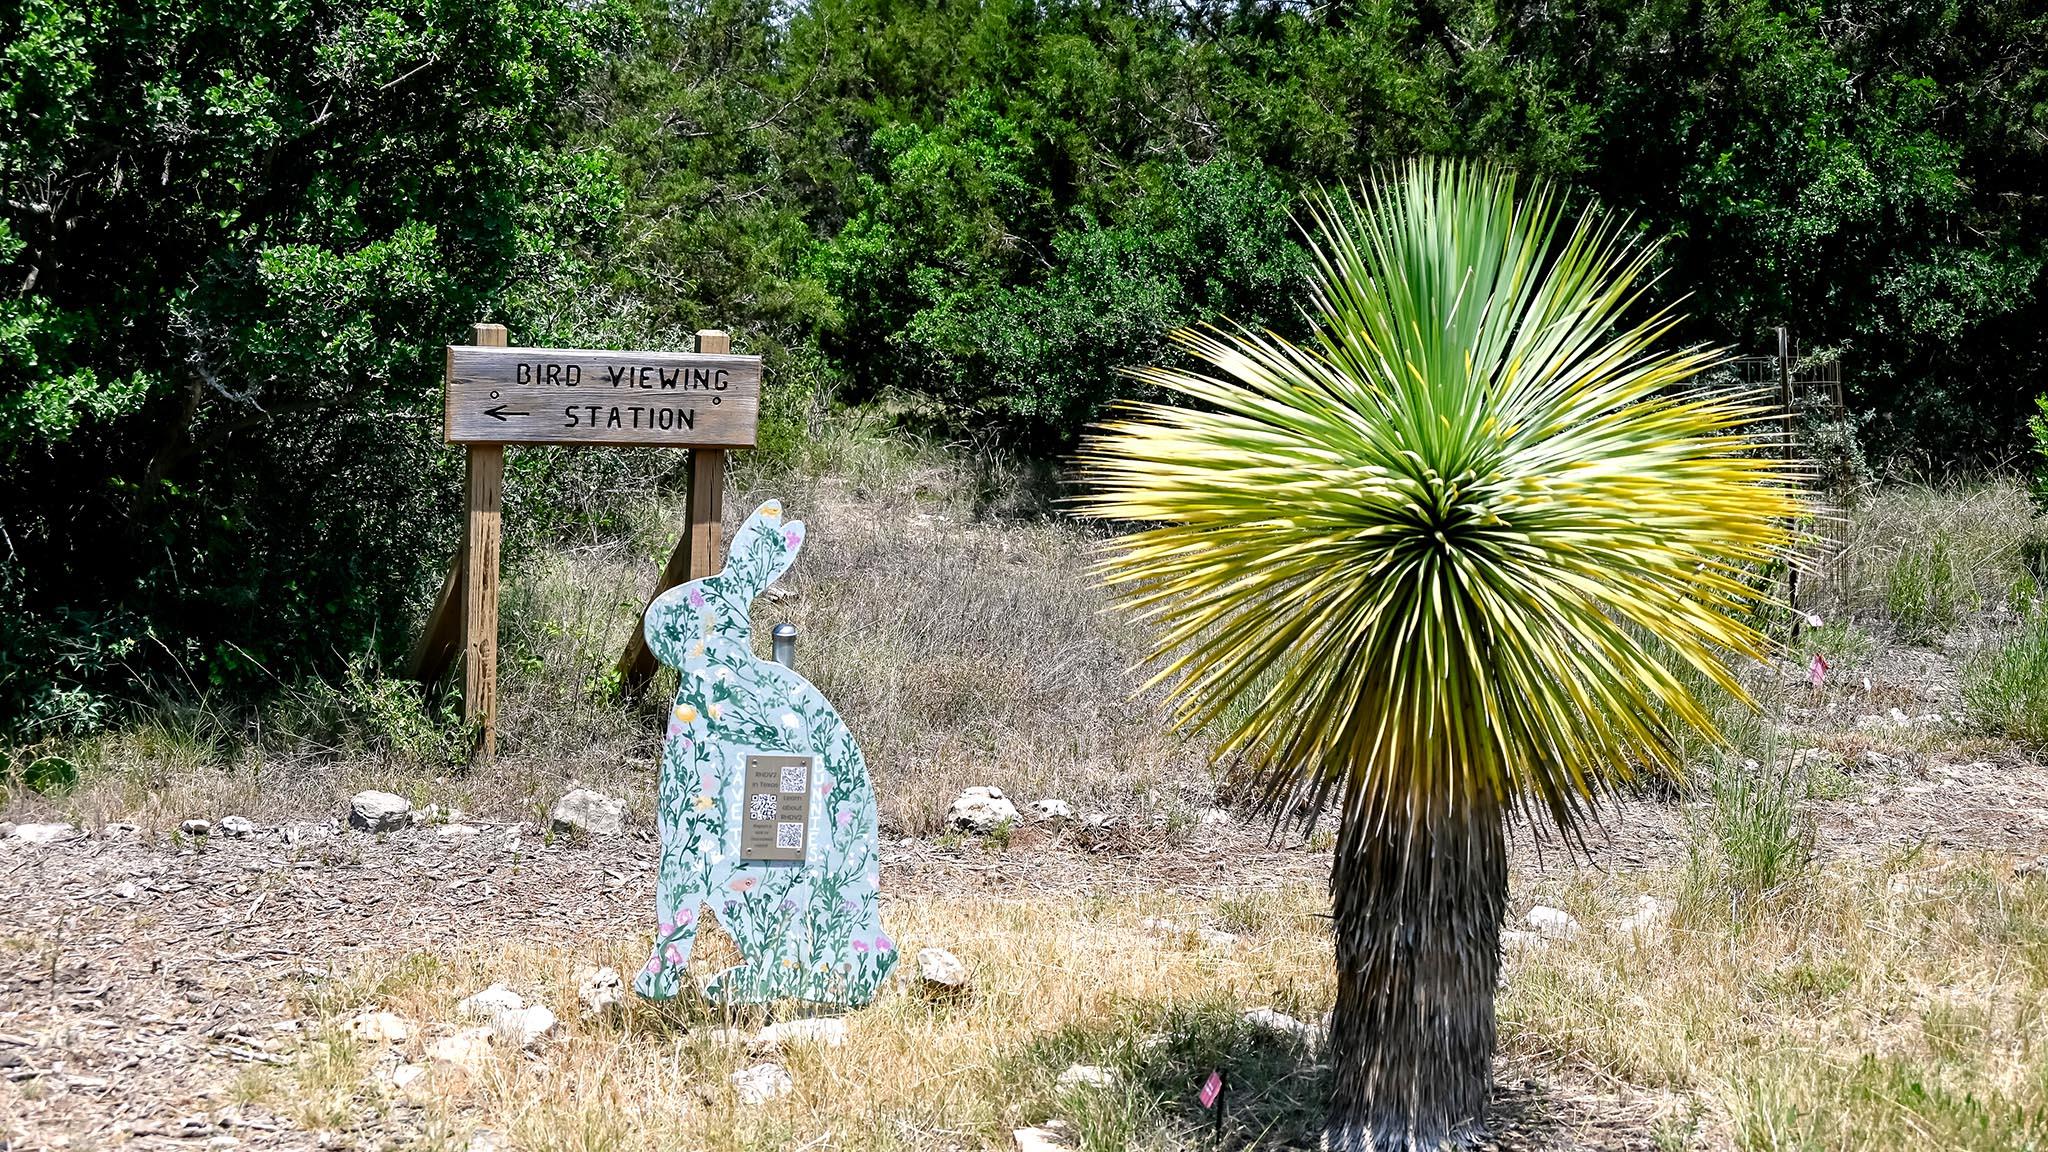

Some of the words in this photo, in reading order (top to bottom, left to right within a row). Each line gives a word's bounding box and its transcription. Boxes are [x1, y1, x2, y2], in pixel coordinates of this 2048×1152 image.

[516, 363, 582, 387] BIRD
[607, 366, 729, 391] VIEWING
[564, 406, 695, 430] STATION
[731, 751, 745, 820] SAVE
[808, 754, 824, 862] BUNNIES
[729, 827, 741, 857] TX
